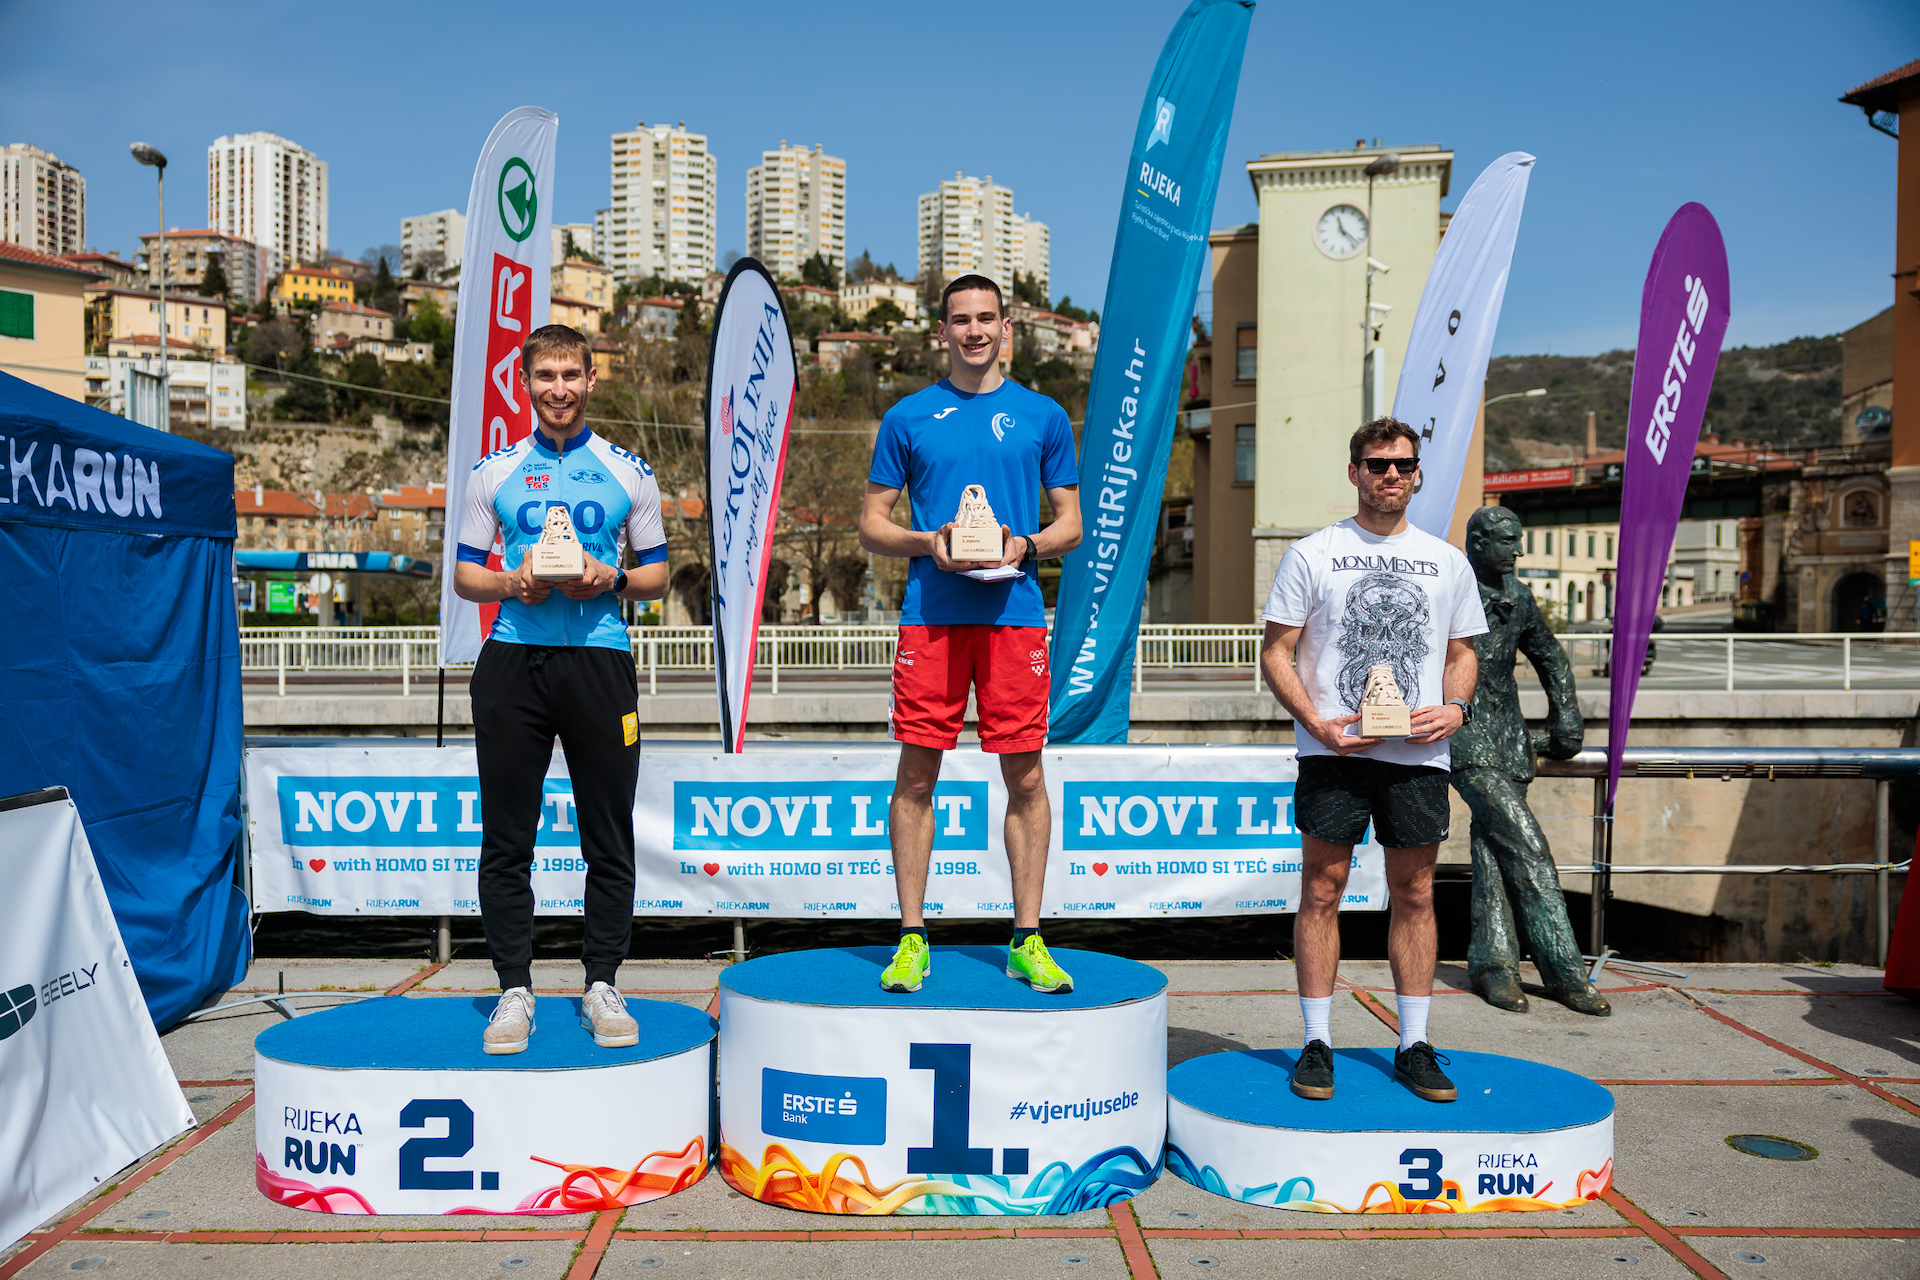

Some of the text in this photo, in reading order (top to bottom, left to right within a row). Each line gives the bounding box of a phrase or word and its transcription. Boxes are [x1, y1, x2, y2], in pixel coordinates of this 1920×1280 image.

[1139, 161, 1182, 207] RIJEKA
[1645, 318, 1697, 466] ERSTE
[1332, 555, 1439, 577] MONUMENTS
[294, 790, 577, 833] NOVI LT
[690, 796, 972, 836] NOVI LT
[1079, 795, 1302, 836] NOVI LI
[292, 856, 304, 871] In
[333, 858, 372, 872] with
[376, 858, 427, 872] HOMO
[432, 858, 450, 872] SI
[454, 858, 480, 872] TE
[680, 862, 698, 875] In
[726, 862, 764, 876] with
[769, 862, 822, 876] HOMO
[826, 862, 844, 876] SI
[848, 858, 881, 876] TEĆ
[935, 861, 981, 875] 1998.
[1070, 858, 1303, 876] In with HOMO SI TEĆ sinc
[287, 895, 332, 907] RIJEKARUN
[366, 899, 420, 908] RIJEKARUN
[716, 901, 770, 910] RIJEKARUN
[804, 902, 857, 911] RIJEKARUN
[890, 902, 944, 911] RIRUN
[977, 902, 1015, 911] RIJEKAR
[1063, 902, 1116, 911] RIJEKARUN
[1149, 901, 1202, 910] RIJEKARUN
[1236, 899, 1287, 909] RIJEKARUN
[40, 962, 99, 1008] GEELY
[782, 1092, 836, 1115] ERSTE
[907, 1042, 1029, 1175] 1.
[1009, 1090, 1139, 1124] #vjerujusebe
[284, 1106, 363, 1136] RIJEKA
[782, 1111, 808, 1125] Bank
[399, 1098, 500, 1191] 2.
[1478, 1153, 1539, 1169] RIJEKA
[1398, 1148, 1457, 1200] 3.
